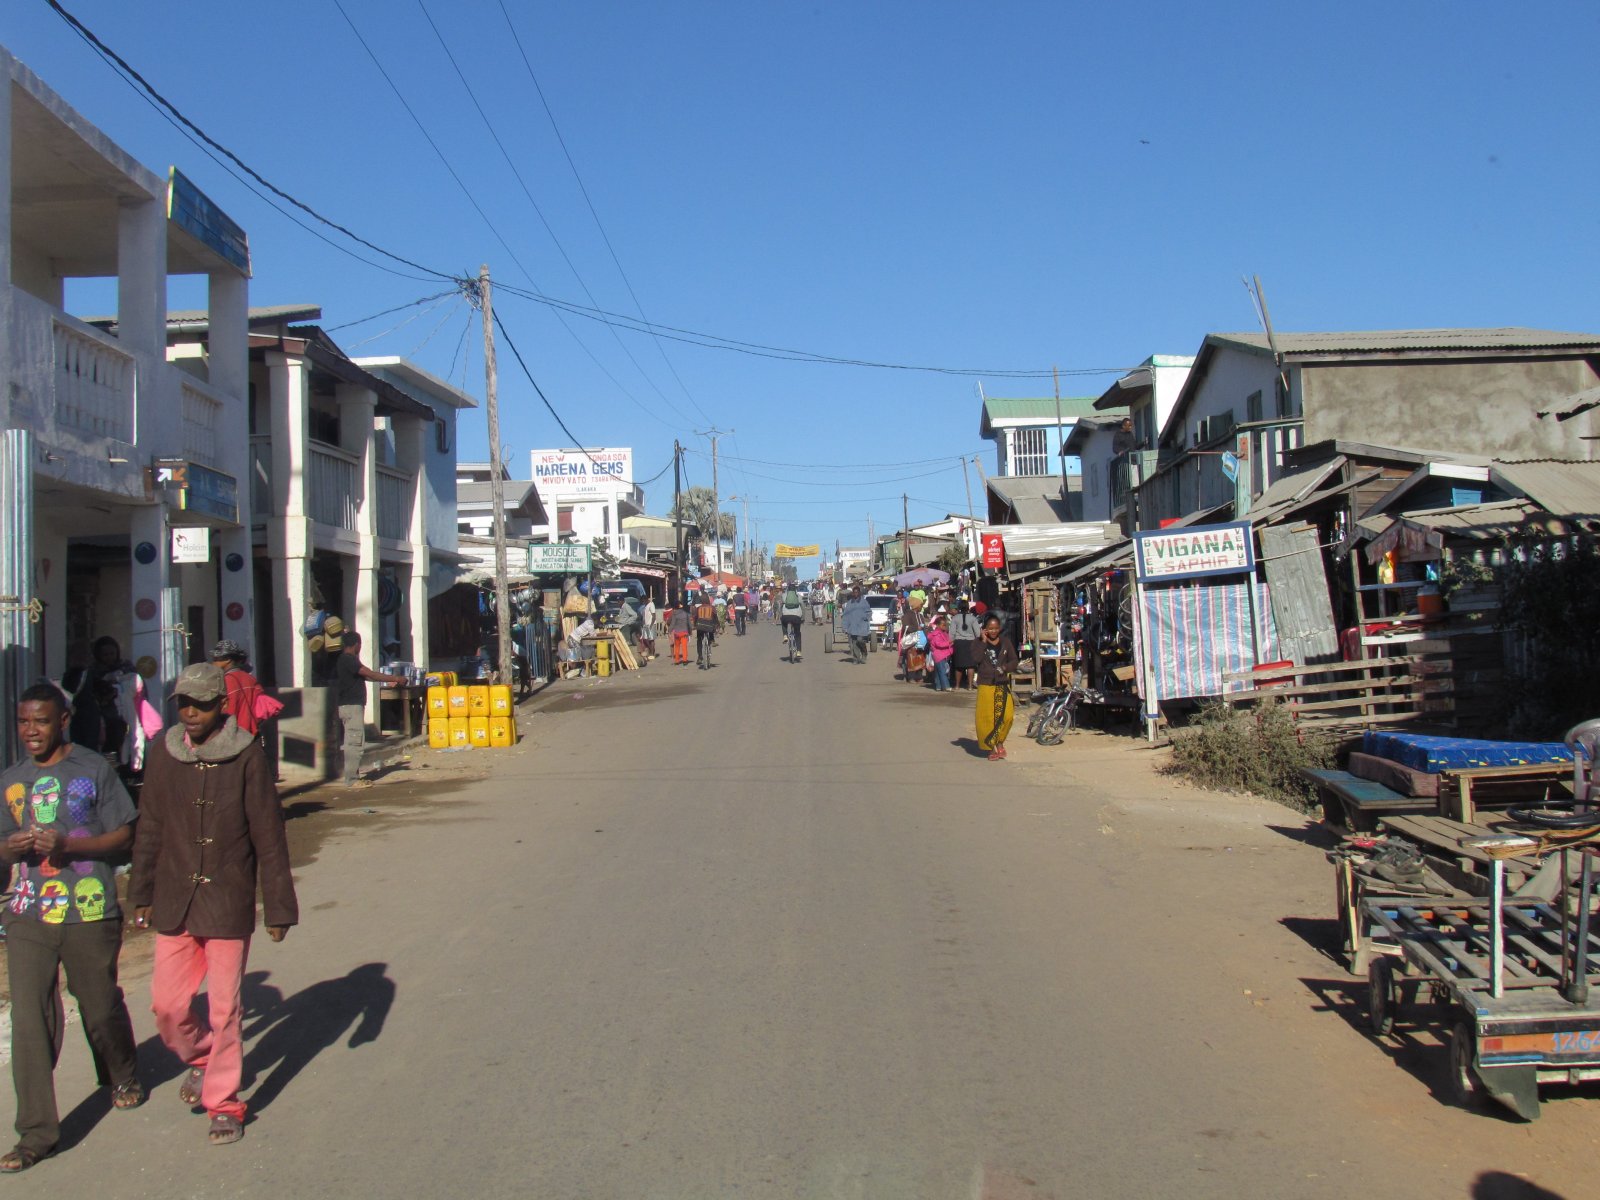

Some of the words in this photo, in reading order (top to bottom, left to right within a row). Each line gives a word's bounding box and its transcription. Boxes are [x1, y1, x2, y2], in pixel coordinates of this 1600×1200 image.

[541, 455, 565, 463] NEW
[536, 463, 587, 476] HARENA
[592, 462, 624, 475] GEMS
[567, 476, 587, 484] VATO
[1152, 532, 1235, 558] VIGANA
[542, 547, 578, 557] MOUSQUE
[1164, 555, 1229, 572] SAPHIR
